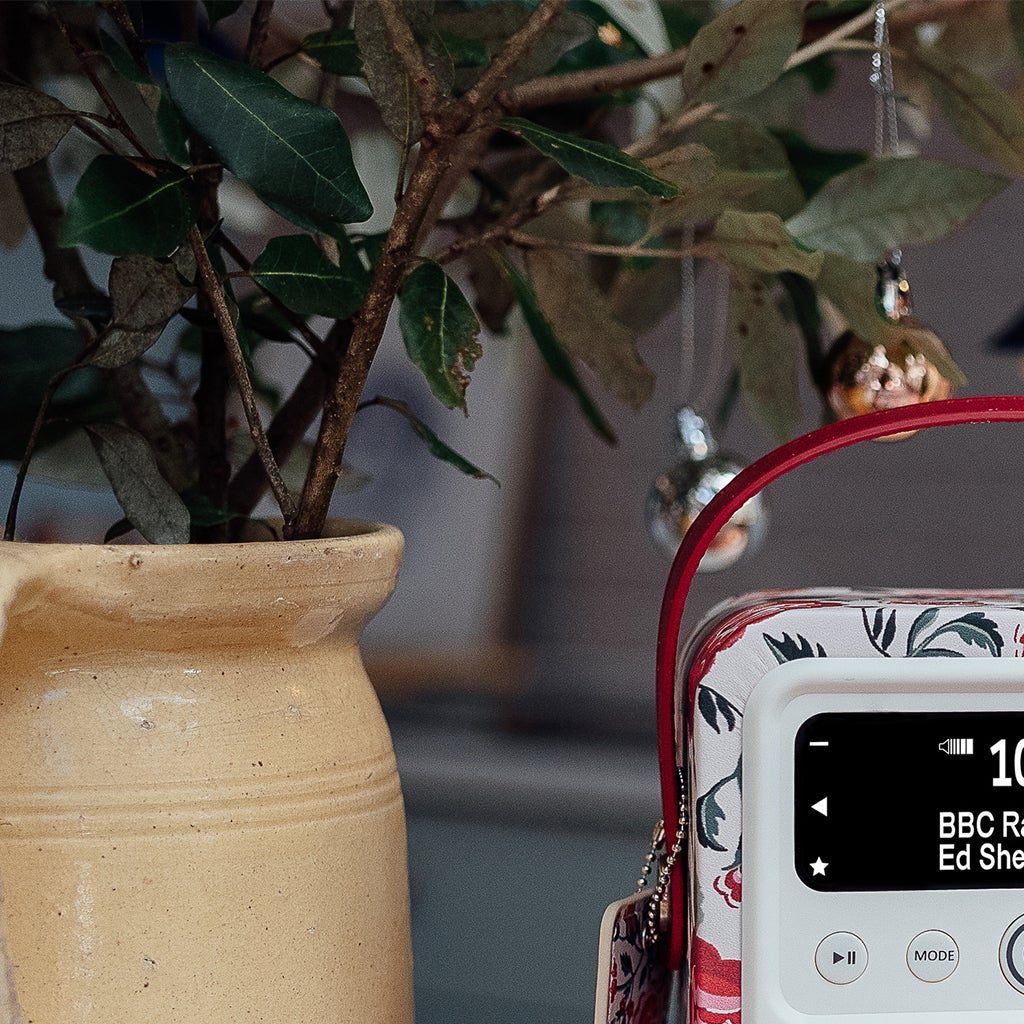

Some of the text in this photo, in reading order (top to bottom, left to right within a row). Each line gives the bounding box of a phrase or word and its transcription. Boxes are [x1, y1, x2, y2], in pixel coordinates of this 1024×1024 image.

[939, 811, 995, 839] BBC
[939, 843, 971, 871] Ed
[914, 948, 955, 963] MODE
